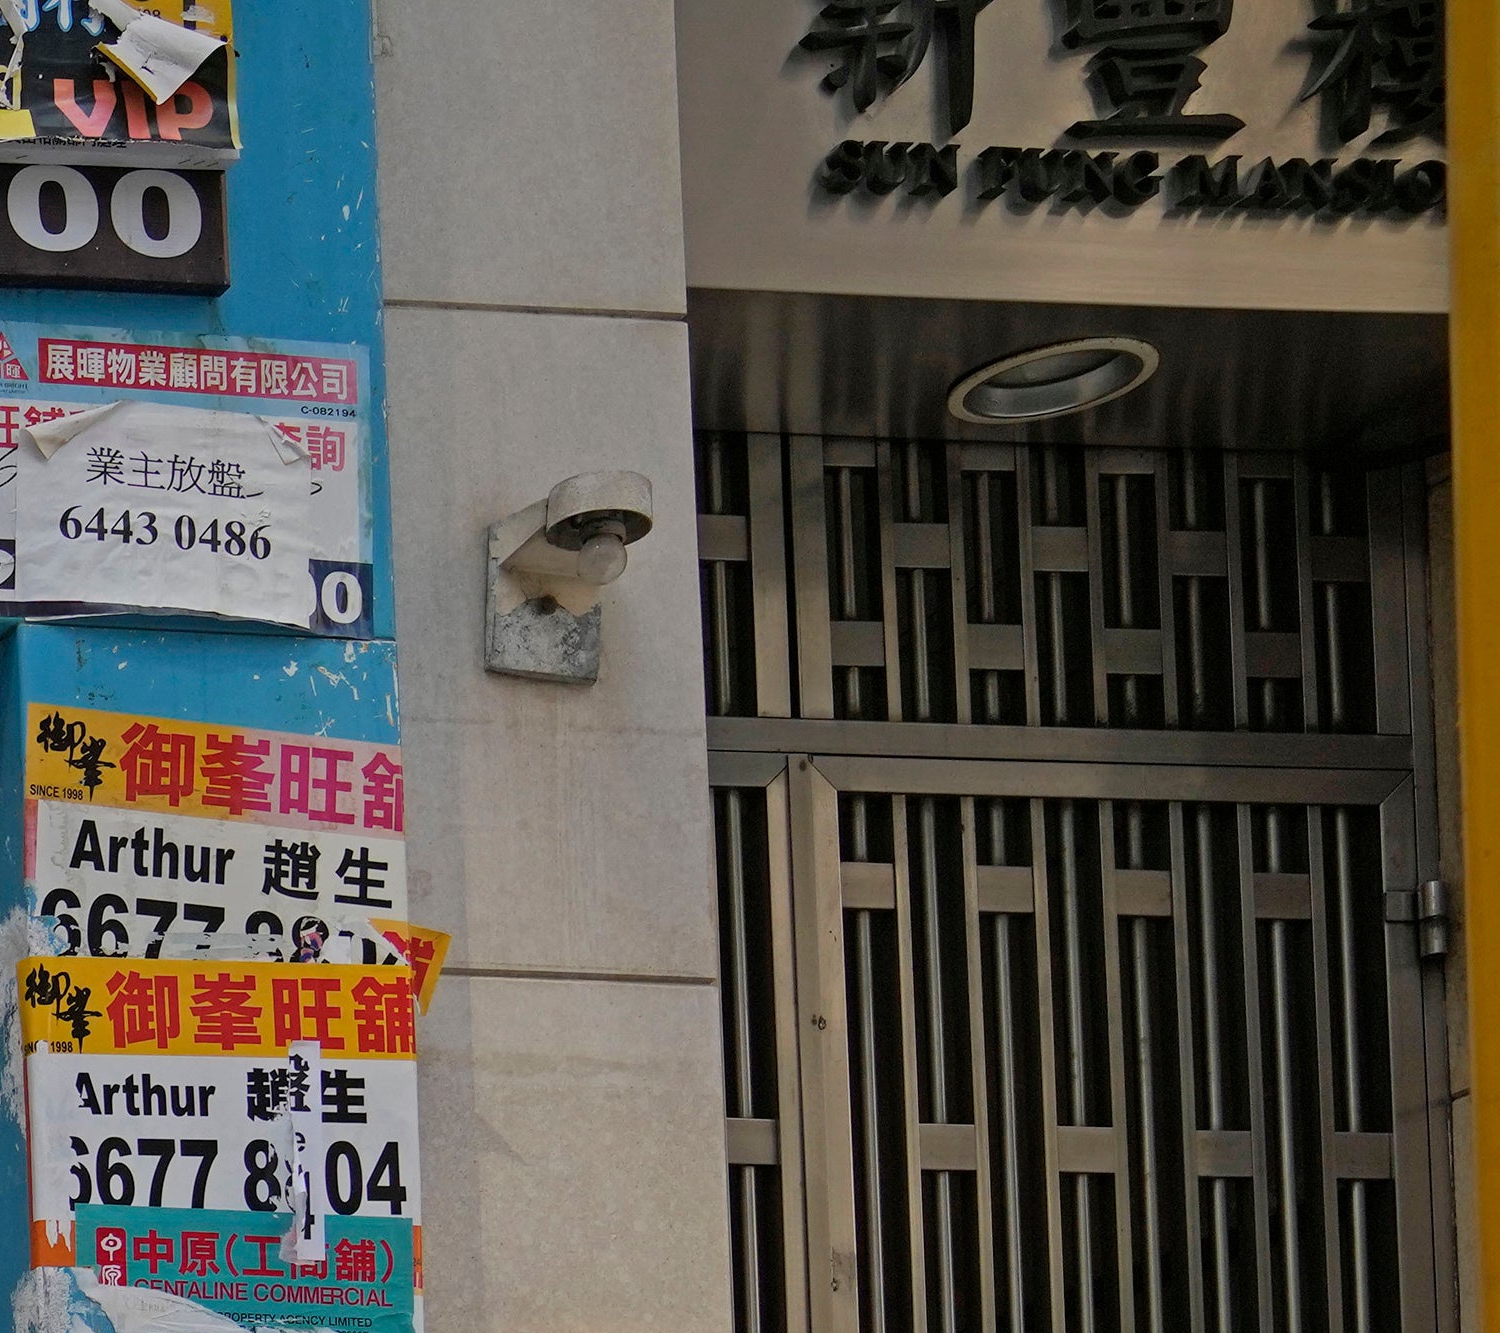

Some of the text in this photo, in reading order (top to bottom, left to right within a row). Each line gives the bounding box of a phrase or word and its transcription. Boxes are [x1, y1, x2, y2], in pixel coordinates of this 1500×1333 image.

[53, 77, 215, 142] VIP
[46, 343, 349, 402] 展暉物業顧問有限公司
[300, 404, 357, 419] C-082194
[85, 446, 247, 499] 業主放盤
[58, 504, 273, 561] 6443 0486
[29, 783, 84, 801] SINCE 1998
[68, 819, 394, 910] Arthur 趙生
[105, 969, 417, 1055] 御峯旺舖
[50, 1041, 75, 1053] 1998
[75, 1071, 216, 1119] Arthur
[253, 1282, 394, 1308] COMMERCIAL
[327, 1316, 373, 1329] LIMITED
